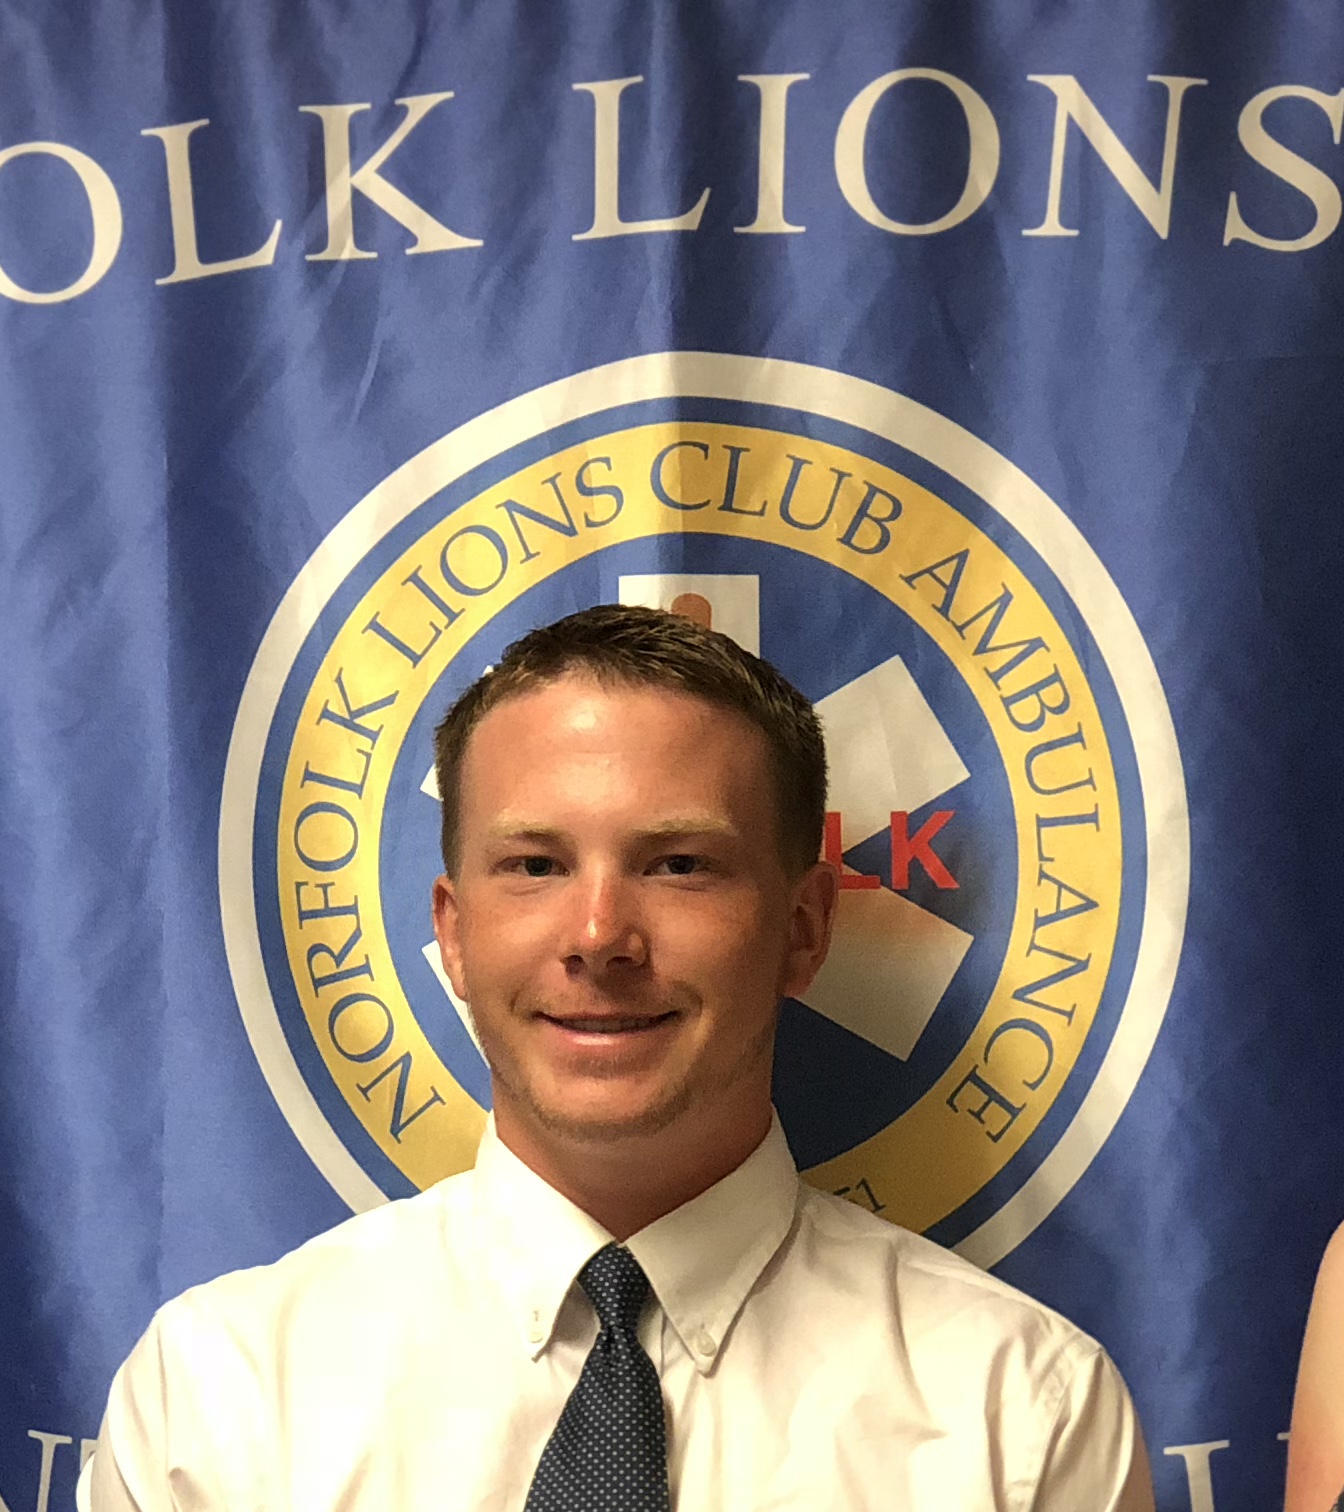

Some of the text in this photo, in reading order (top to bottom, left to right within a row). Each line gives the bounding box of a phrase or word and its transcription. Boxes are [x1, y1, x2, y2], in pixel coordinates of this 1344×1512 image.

[292, 440, 1102, 1146] NORFOLK LIONS CLUB AMBULANCE
